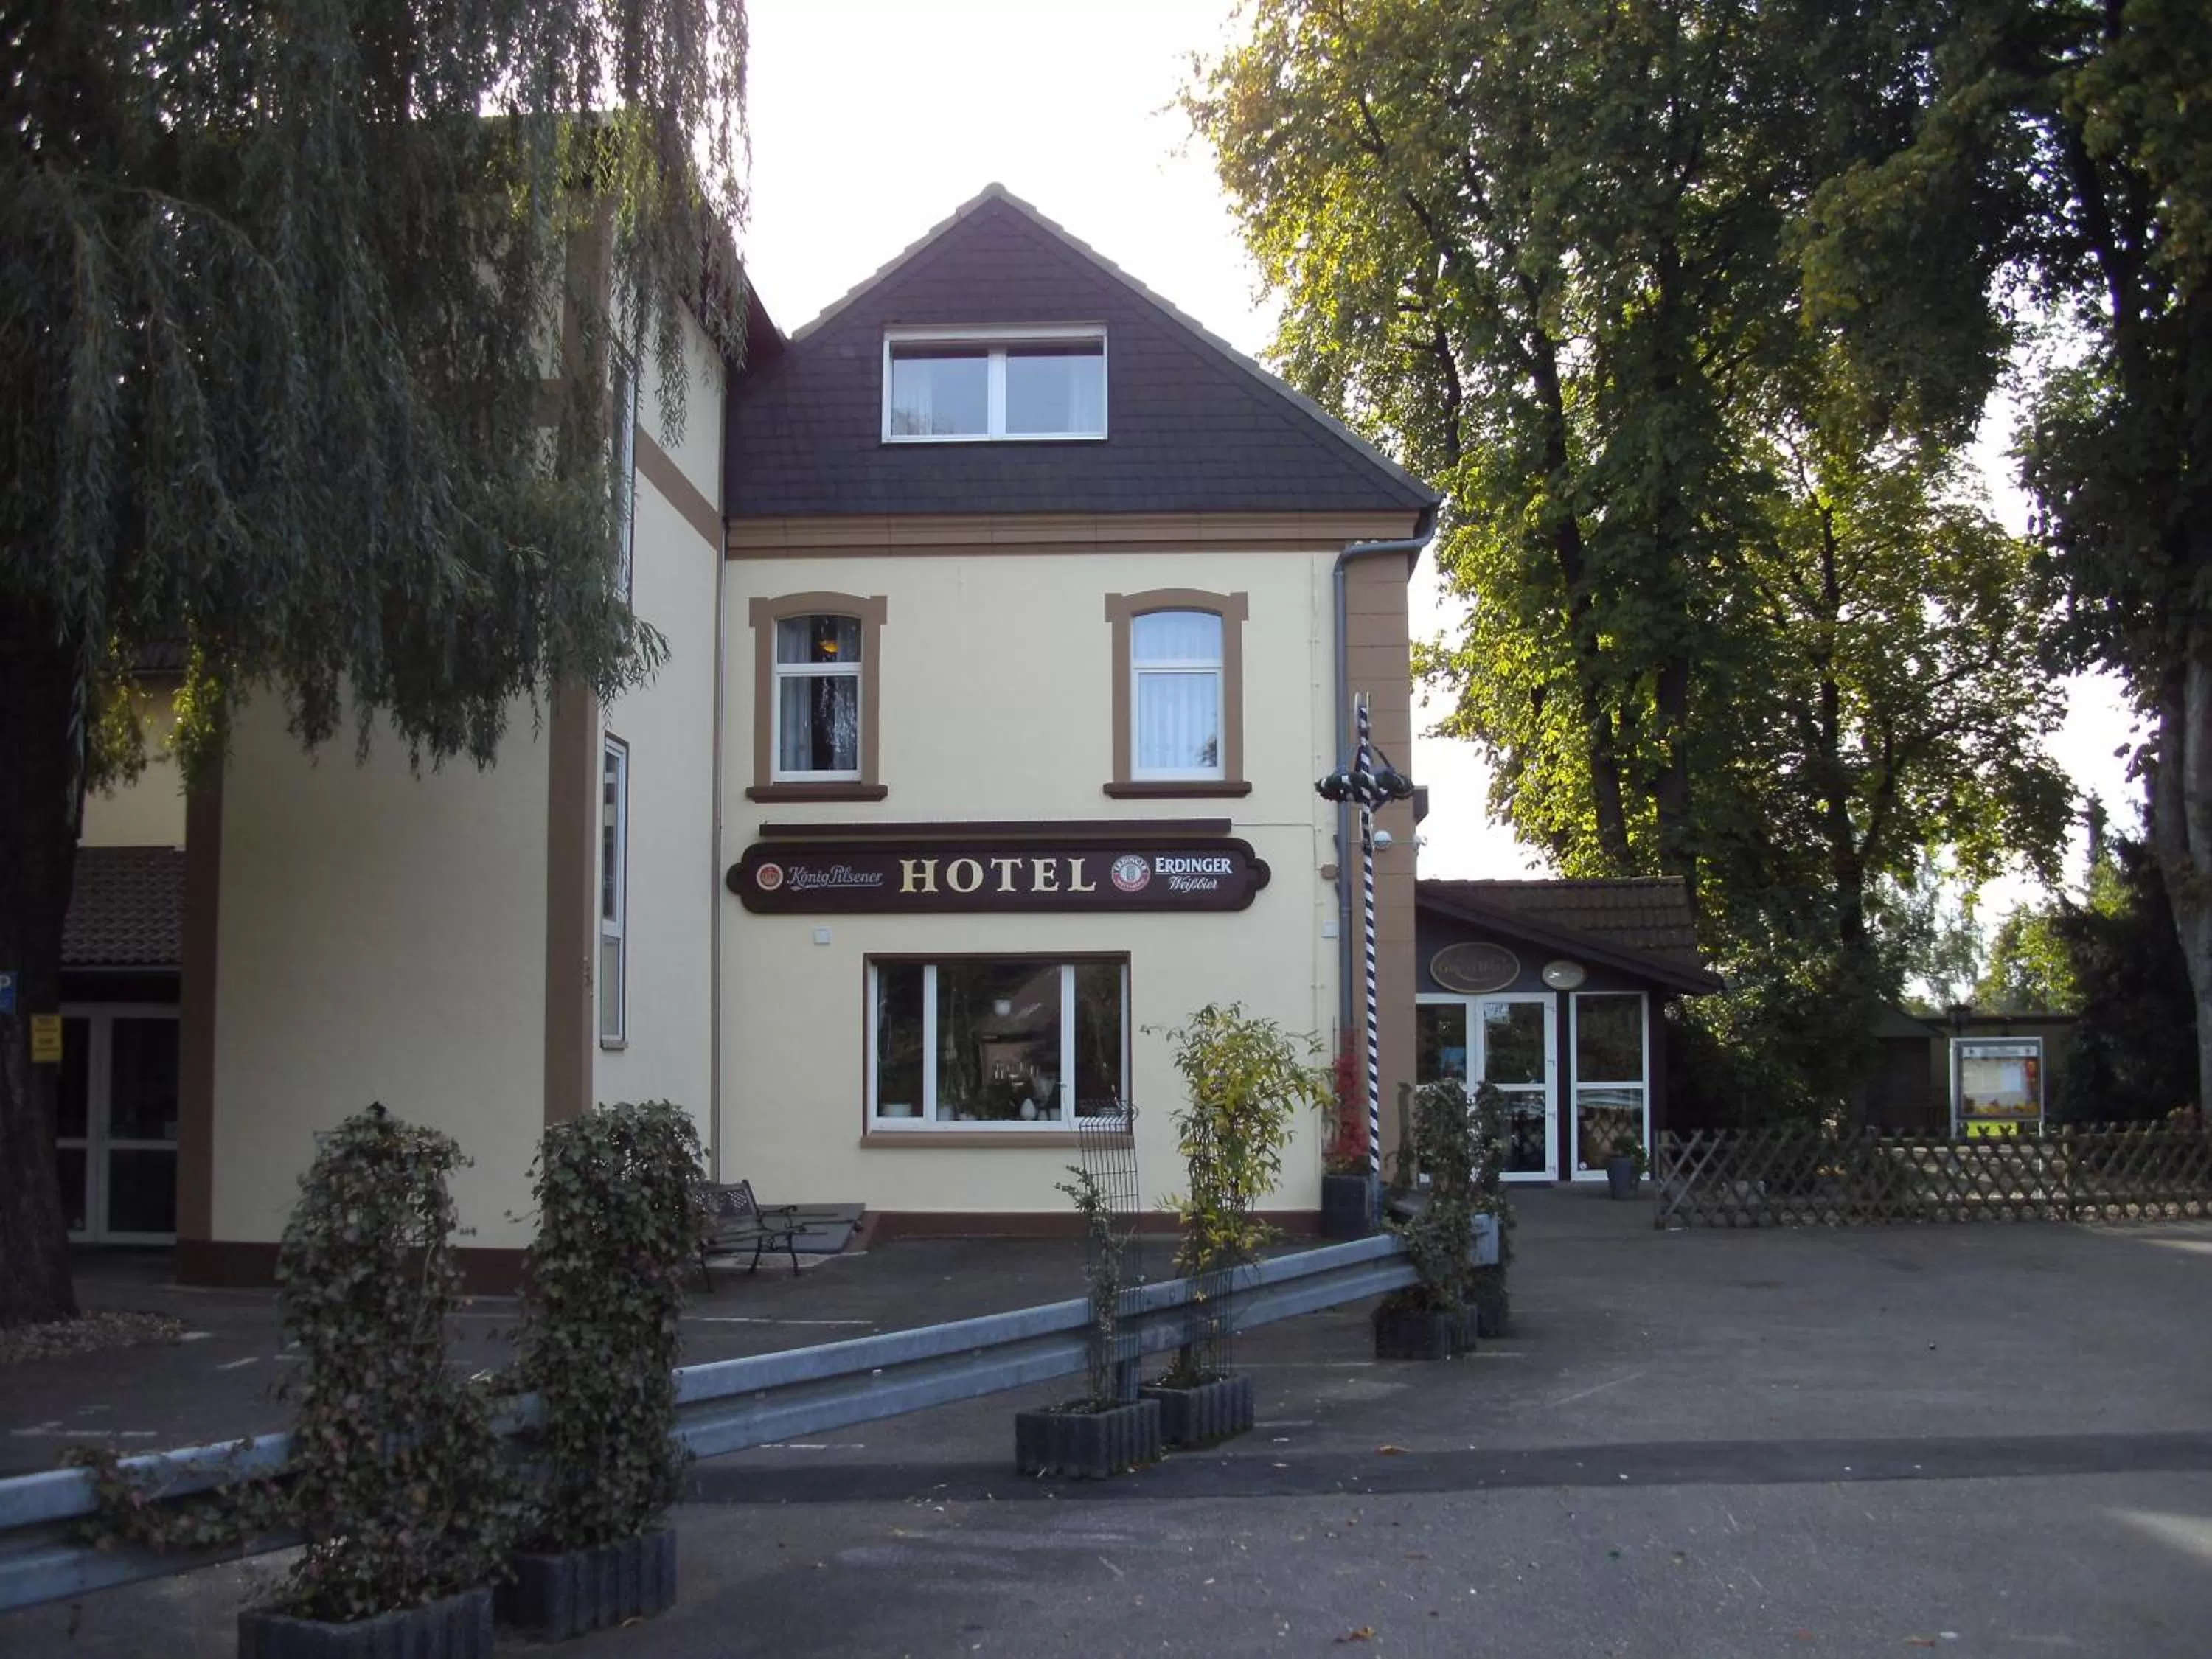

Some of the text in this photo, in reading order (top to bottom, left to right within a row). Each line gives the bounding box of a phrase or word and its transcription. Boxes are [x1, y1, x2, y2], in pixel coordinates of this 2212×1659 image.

[787, 866, 830, 888] König
[829, 864, 884, 886] Pilsener
[899, 858, 1096, 893] HOTEL
[1155, 856, 1232, 874] ERDINGER
